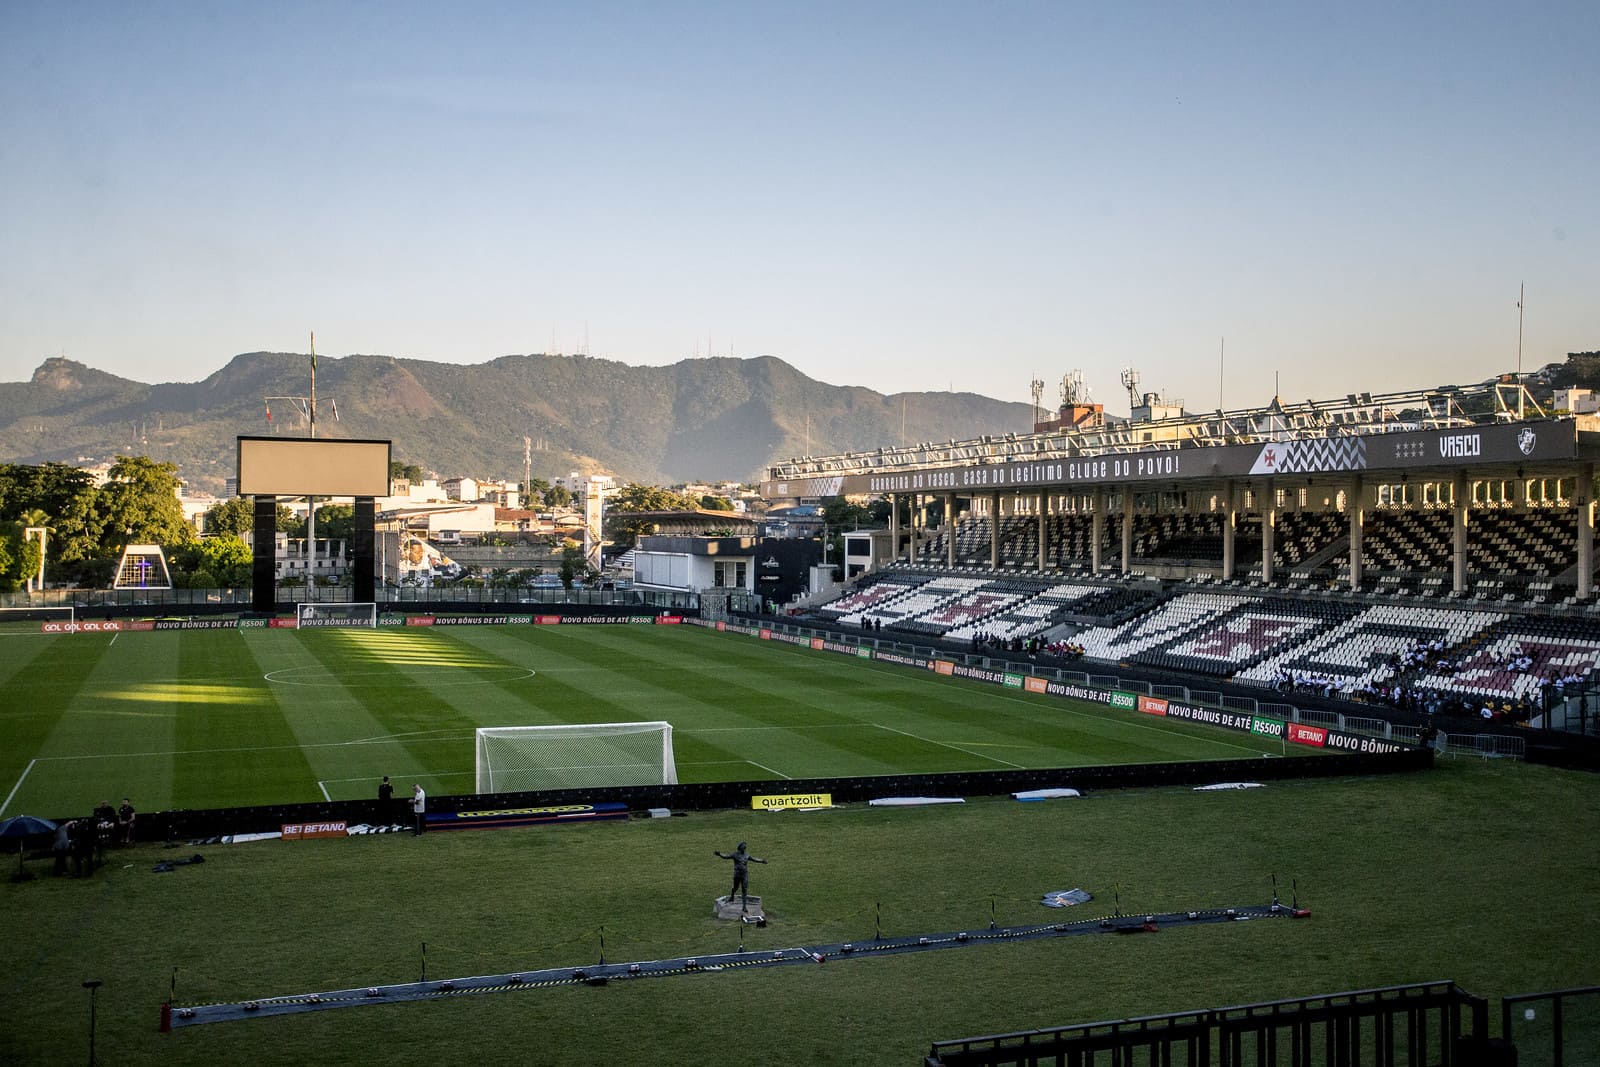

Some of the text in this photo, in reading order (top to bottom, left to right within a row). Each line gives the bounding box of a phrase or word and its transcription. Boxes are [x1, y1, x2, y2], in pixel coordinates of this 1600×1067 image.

[1439, 434, 1481, 458] VASCO
[963, 469, 987, 485] CASA
[992, 467, 1005, 483] DO
[1069, 461, 1106, 479] CLUBE
[1114, 459, 1130, 476] DO
[1138, 455, 1179, 476] POVO!
[181, 620, 205, 628] BÔNUS
[223, 620, 238, 628] ATÉ
[324, 618, 350, 626] BÔNUS
[458, 616, 482, 624] BÔNUS
[494, 616, 507, 624] ATÉ
[583, 615, 606, 623] BÔNUS
[616, 615, 630, 623] ATÉ
[103, 622, 120, 630] GOL
[954, 666, 967, 676] NOVO
[968, 667, 985, 679] BÔNUS
[986, 672, 993, 681] DE
[993, 672, 1004, 683] ATÉ
[1048, 683, 1134, 707] NOVO BÔNUS DE ATÉ R$500
[1146, 701, 1166, 712] BETANO
[1168, 704, 1281, 736] NOVO BÔNUS DE ATÉ R$500
[1298, 729, 1323, 742] BETANO
[1328, 734, 1358, 750] NOVO
[762, 796, 823, 807] quartzolit
[304, 823, 345, 833] BETANO
